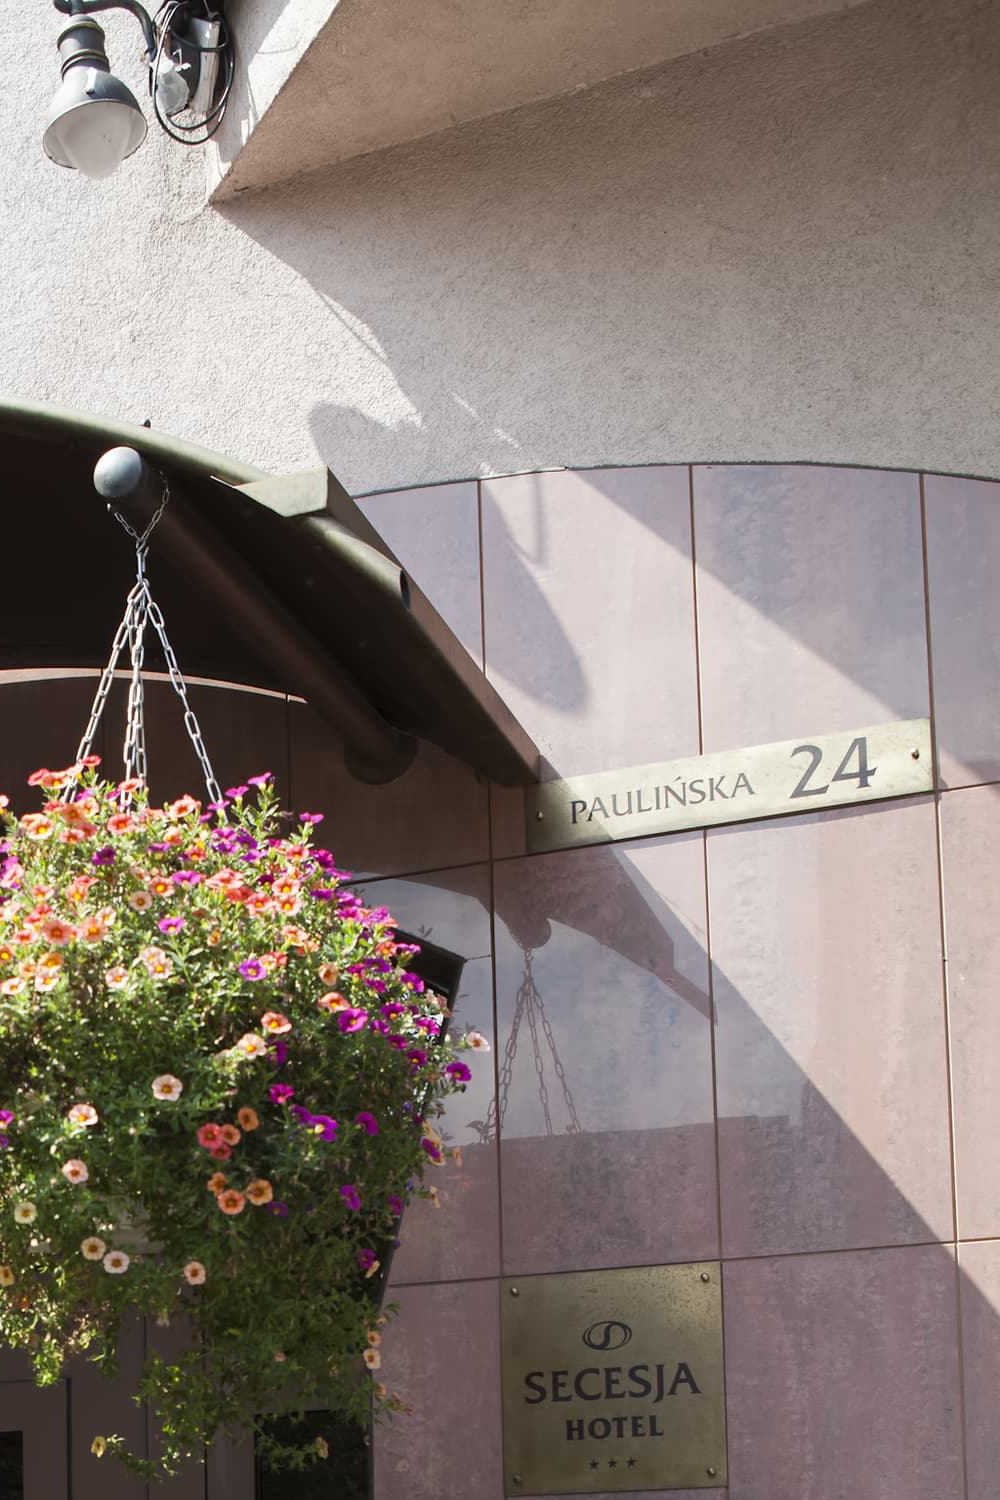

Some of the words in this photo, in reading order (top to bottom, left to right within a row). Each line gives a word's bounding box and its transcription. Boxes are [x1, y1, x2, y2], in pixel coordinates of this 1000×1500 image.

[569, 772, 756, 825] PAULIŃSKA
[788, 736, 878, 800] 24
[523, 1361, 703, 1405] SECESJA
[565, 1414, 665, 1441] HOTEL
